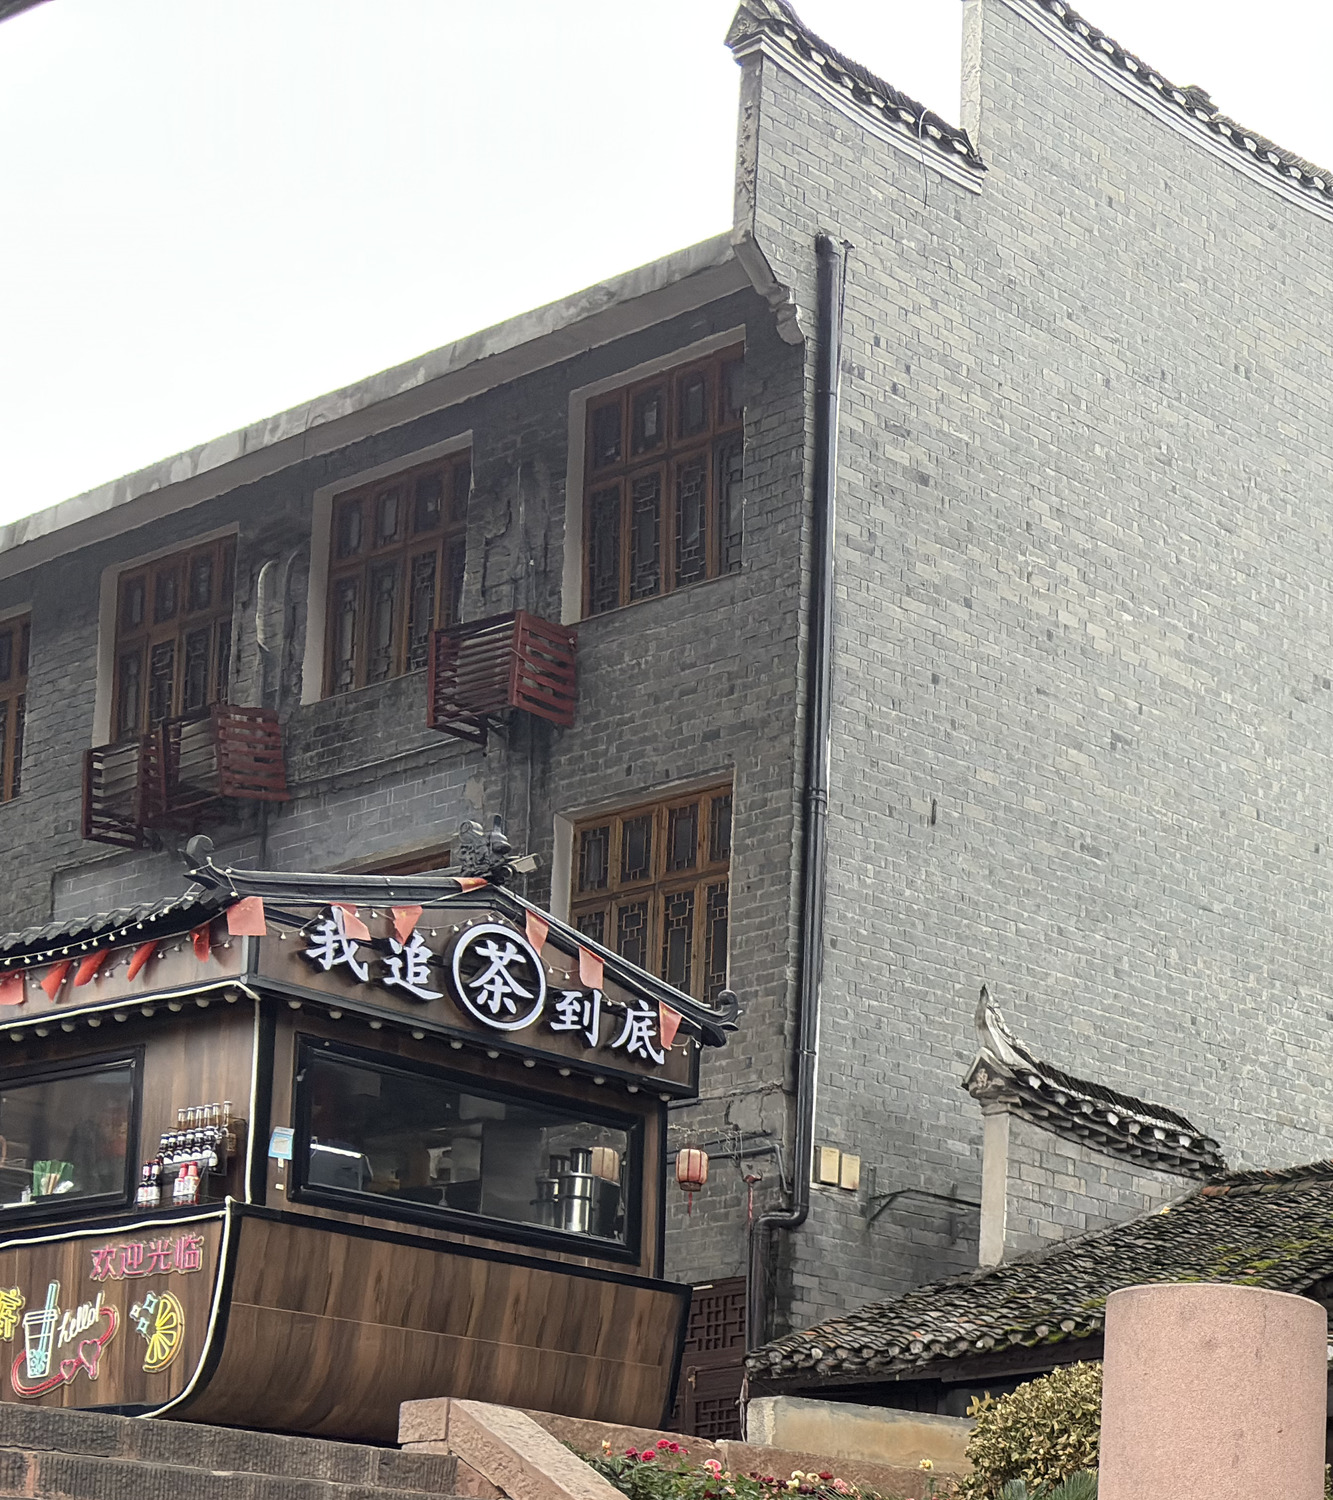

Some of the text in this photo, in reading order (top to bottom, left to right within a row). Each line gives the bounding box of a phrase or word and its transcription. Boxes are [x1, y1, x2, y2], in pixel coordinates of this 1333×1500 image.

[306, 905, 666, 1066] 我追茶到底
[90, 1235, 201, 1279] 欢迎光临
